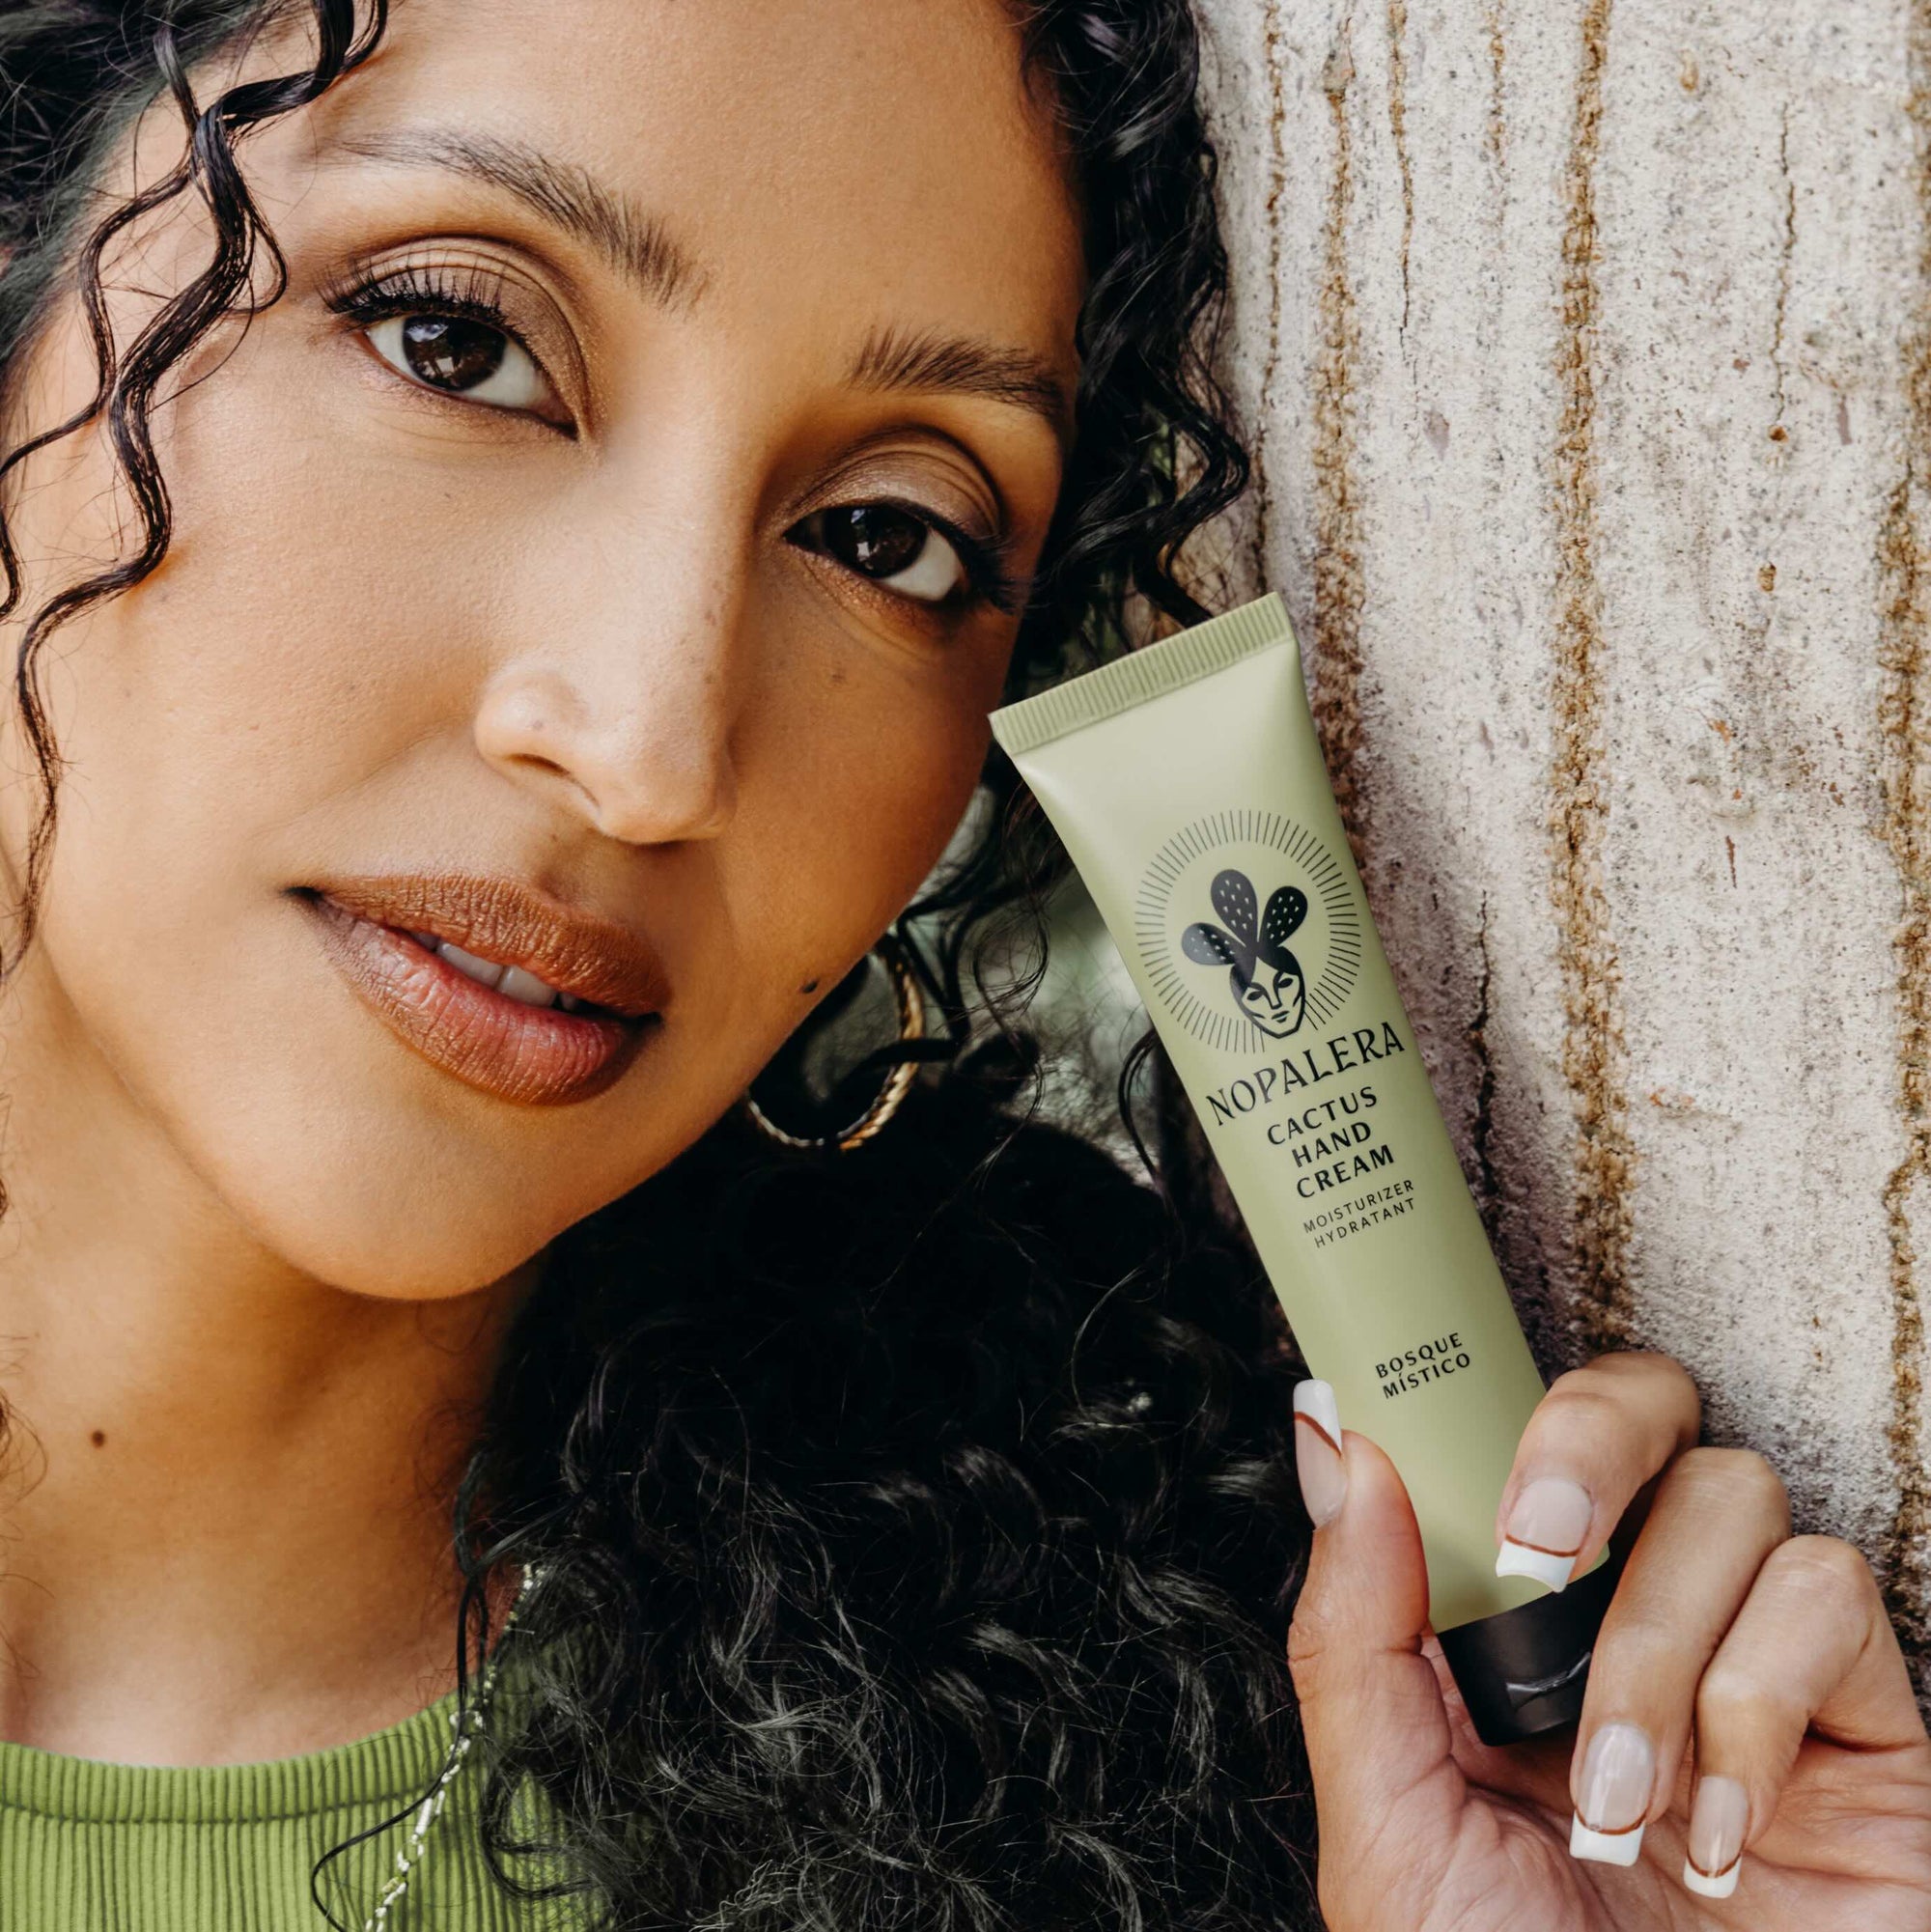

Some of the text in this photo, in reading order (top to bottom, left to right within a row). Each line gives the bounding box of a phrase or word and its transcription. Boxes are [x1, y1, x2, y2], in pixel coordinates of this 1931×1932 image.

[1206, 1022, 1405, 1126] NOPALERA
[1267, 1085, 1378, 1145] CACTUS
[1291, 1121, 1372, 1168] HAND
[1297, 1144, 1394, 1198] CREAM
[1303, 1179, 1414, 1234] MOISTURIZER
[1314, 1197, 1415, 1248] HYDRATANT
[1376, 1332, 1463, 1379] BOSQUE
[1383, 1353, 1470, 1399] MÍSTICO
